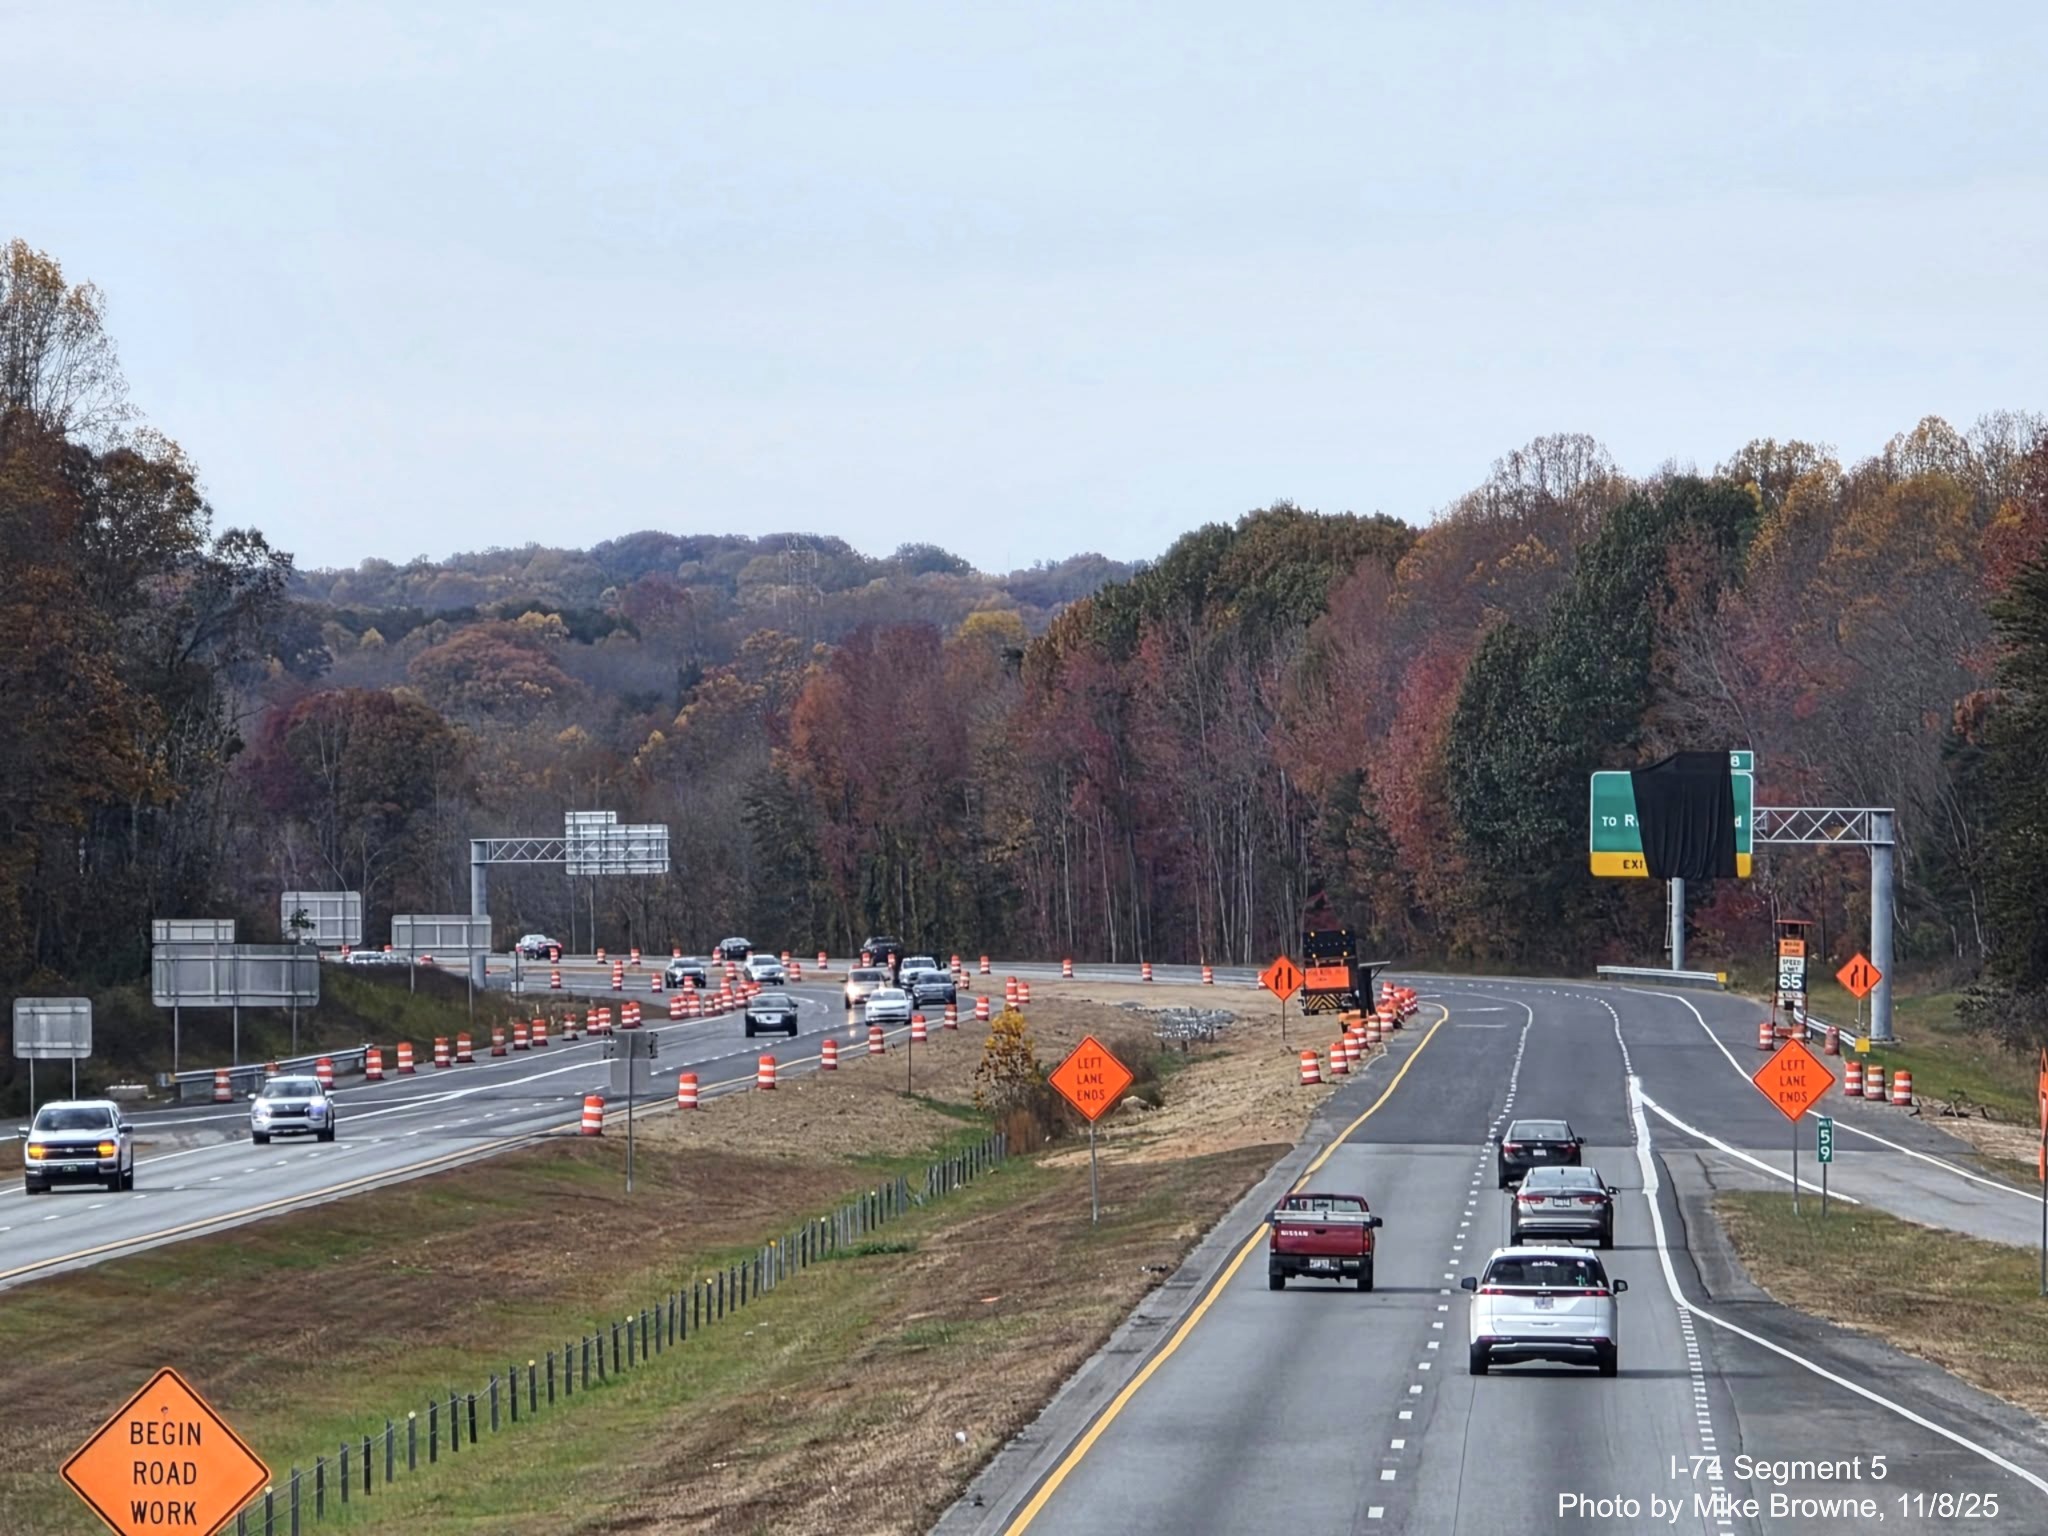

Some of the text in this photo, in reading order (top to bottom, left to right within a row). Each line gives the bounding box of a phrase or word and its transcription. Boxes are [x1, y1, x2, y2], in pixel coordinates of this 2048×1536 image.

[1623, 859, 1643, 870] EXI
[1782, 958, 1802, 966] SPEED
[1779, 973, 1802, 989] 65
[1077, 1056, 1102, 1069] LEFT
[1780, 1059, 1805, 1071] LEFT
[1076, 1073, 1104, 1085] LANE
[1779, 1075, 1807, 1087] LANE
[1076, 1089, 1105, 1101] ENDS
[1779, 1091, 1808, 1103] ENDS
[1280, 1229, 1309, 1237] NISSAN
[130, 1421, 201, 1446] BEGIN
[133, 1461, 197, 1486] ROAD
[130, 1500, 197, 1526] WORK
